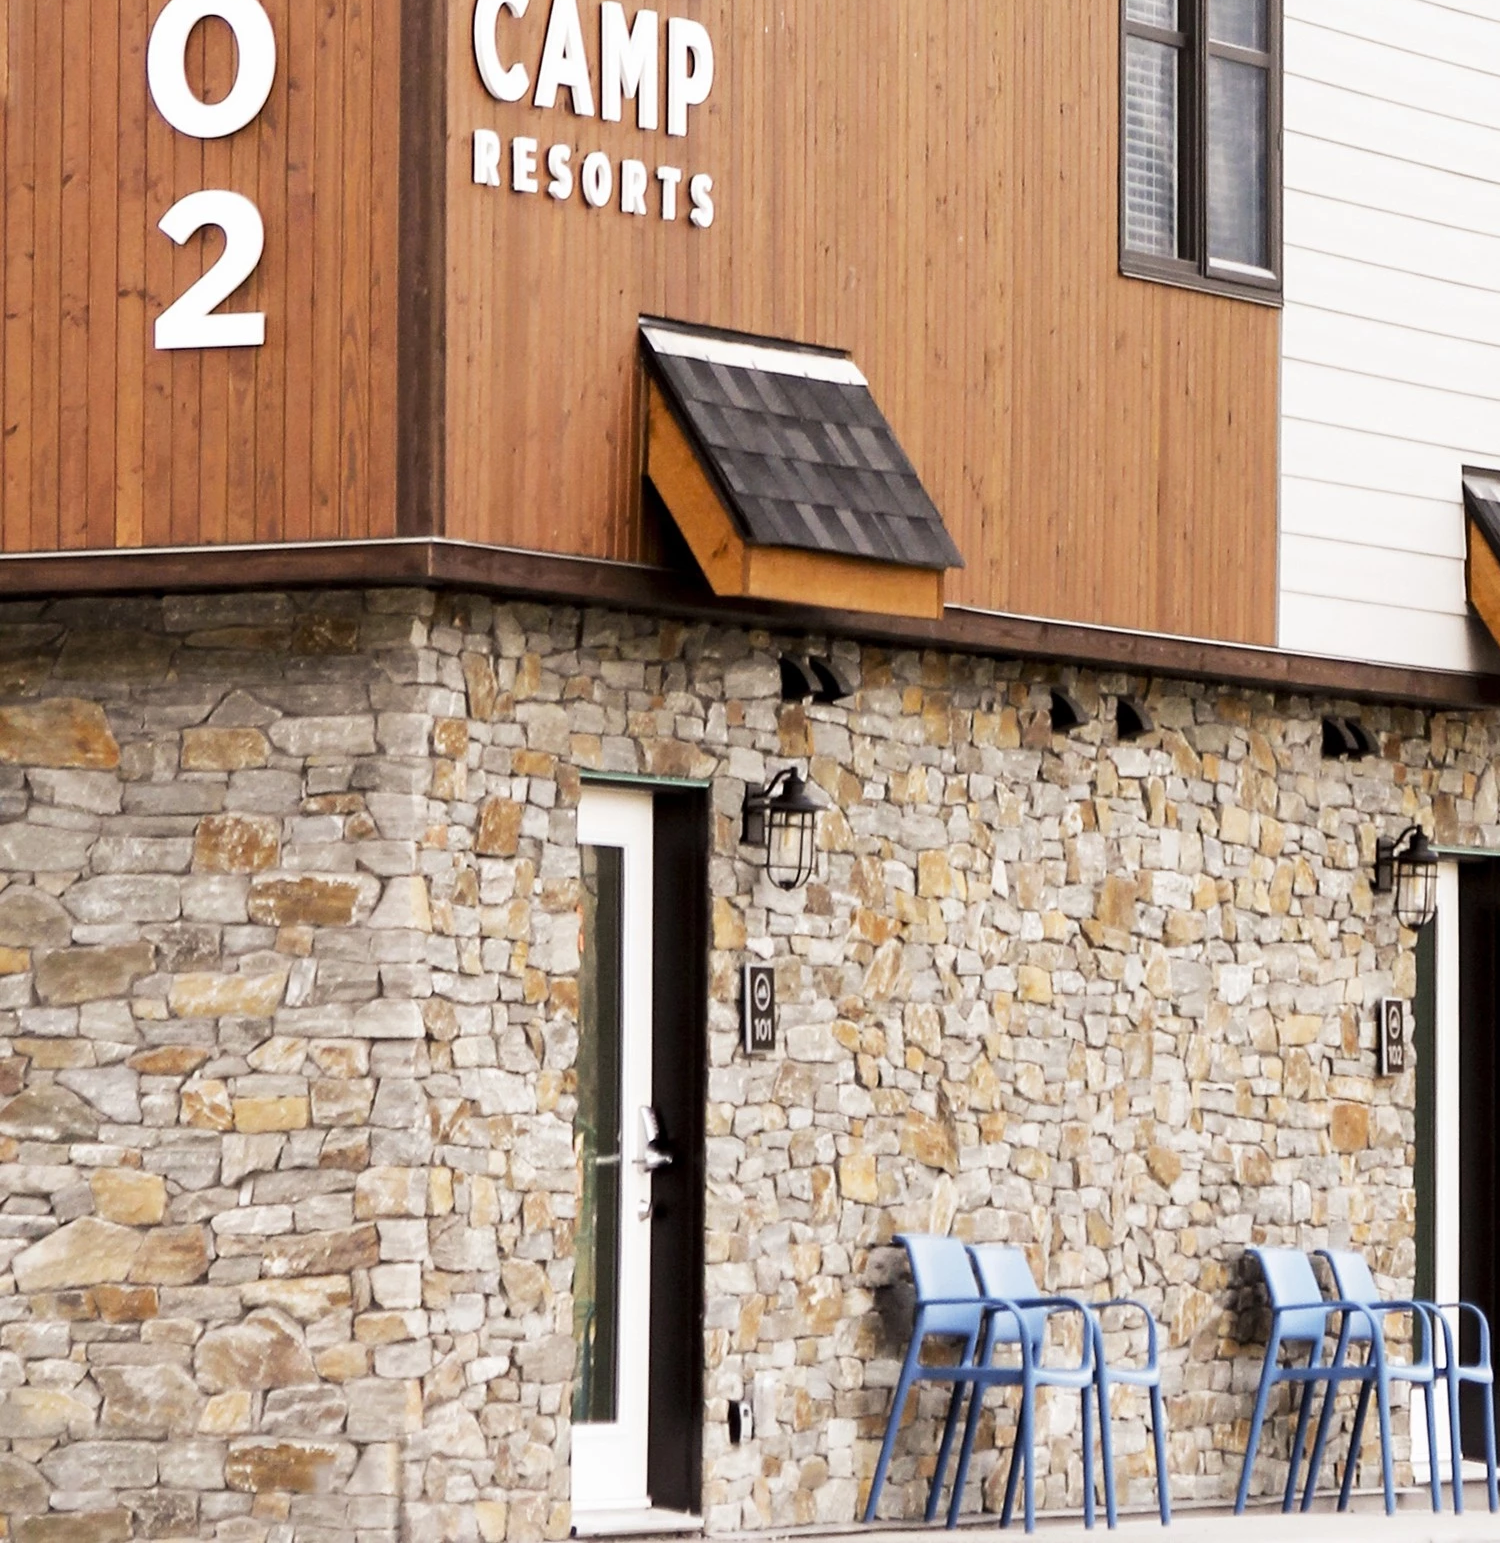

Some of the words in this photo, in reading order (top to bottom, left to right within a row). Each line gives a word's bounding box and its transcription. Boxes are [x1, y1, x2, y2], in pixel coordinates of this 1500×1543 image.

[473, 128, 714, 228] RESORTS
[754, 1018, 772, 1042] 101
[1388, 1045, 1403, 1066] 102
